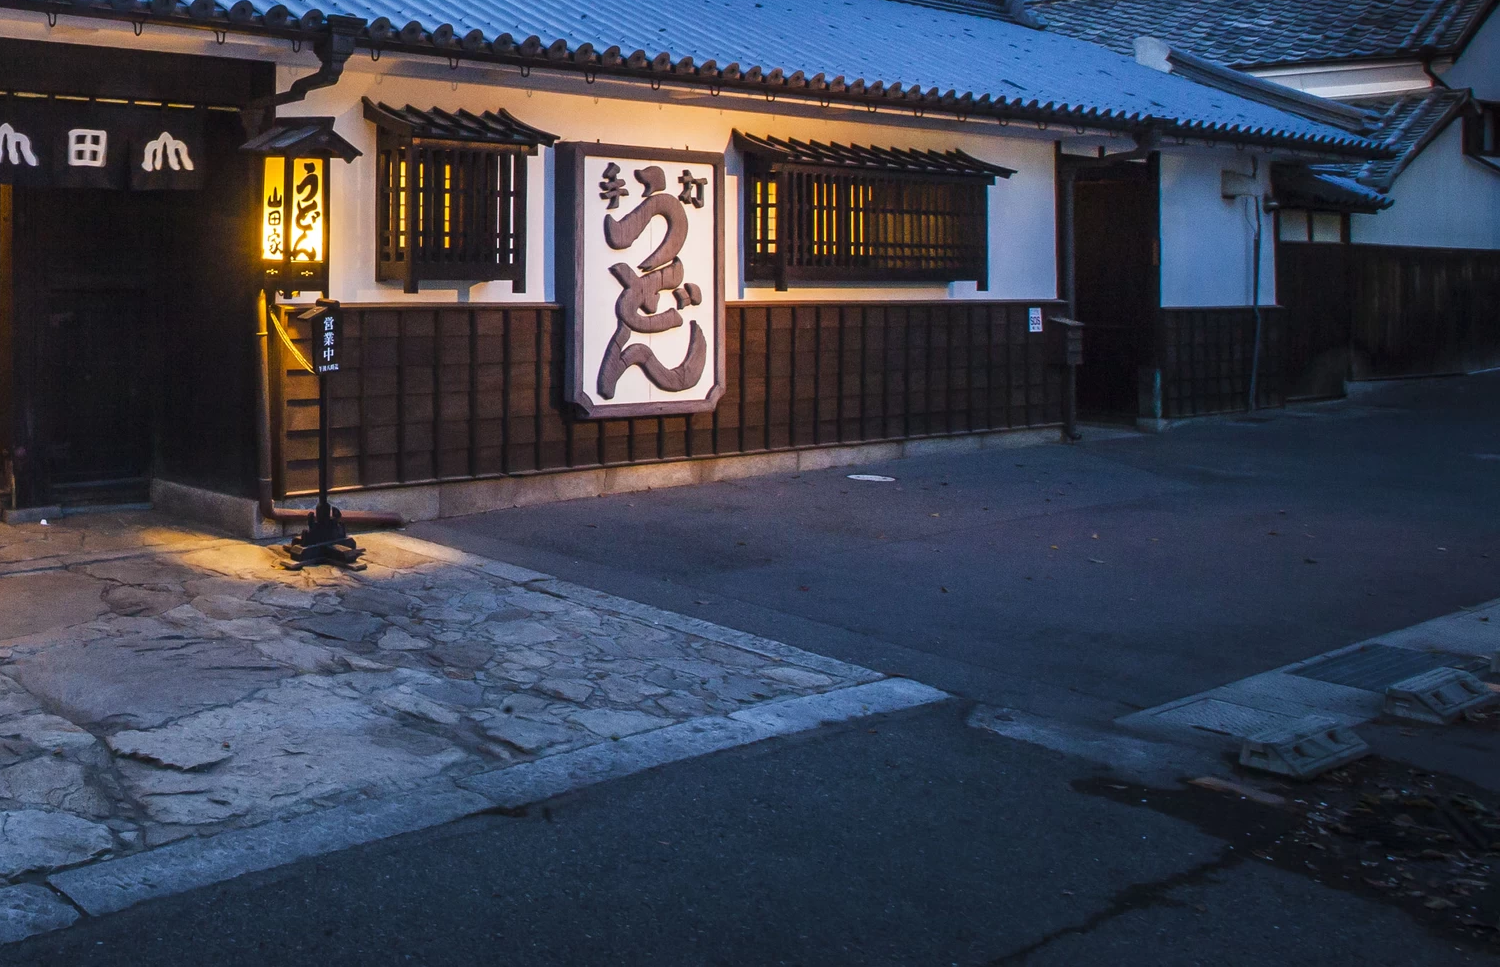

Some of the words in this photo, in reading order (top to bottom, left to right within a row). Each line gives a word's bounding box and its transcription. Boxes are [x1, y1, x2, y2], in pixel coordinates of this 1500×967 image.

[267, 187, 284, 255] 山田家
[291, 162, 320, 261] うどん
[597, 165, 707, 400] うどん
[323, 316, 335, 362] 営業中
[1030, 316, 1041, 325] SOS
